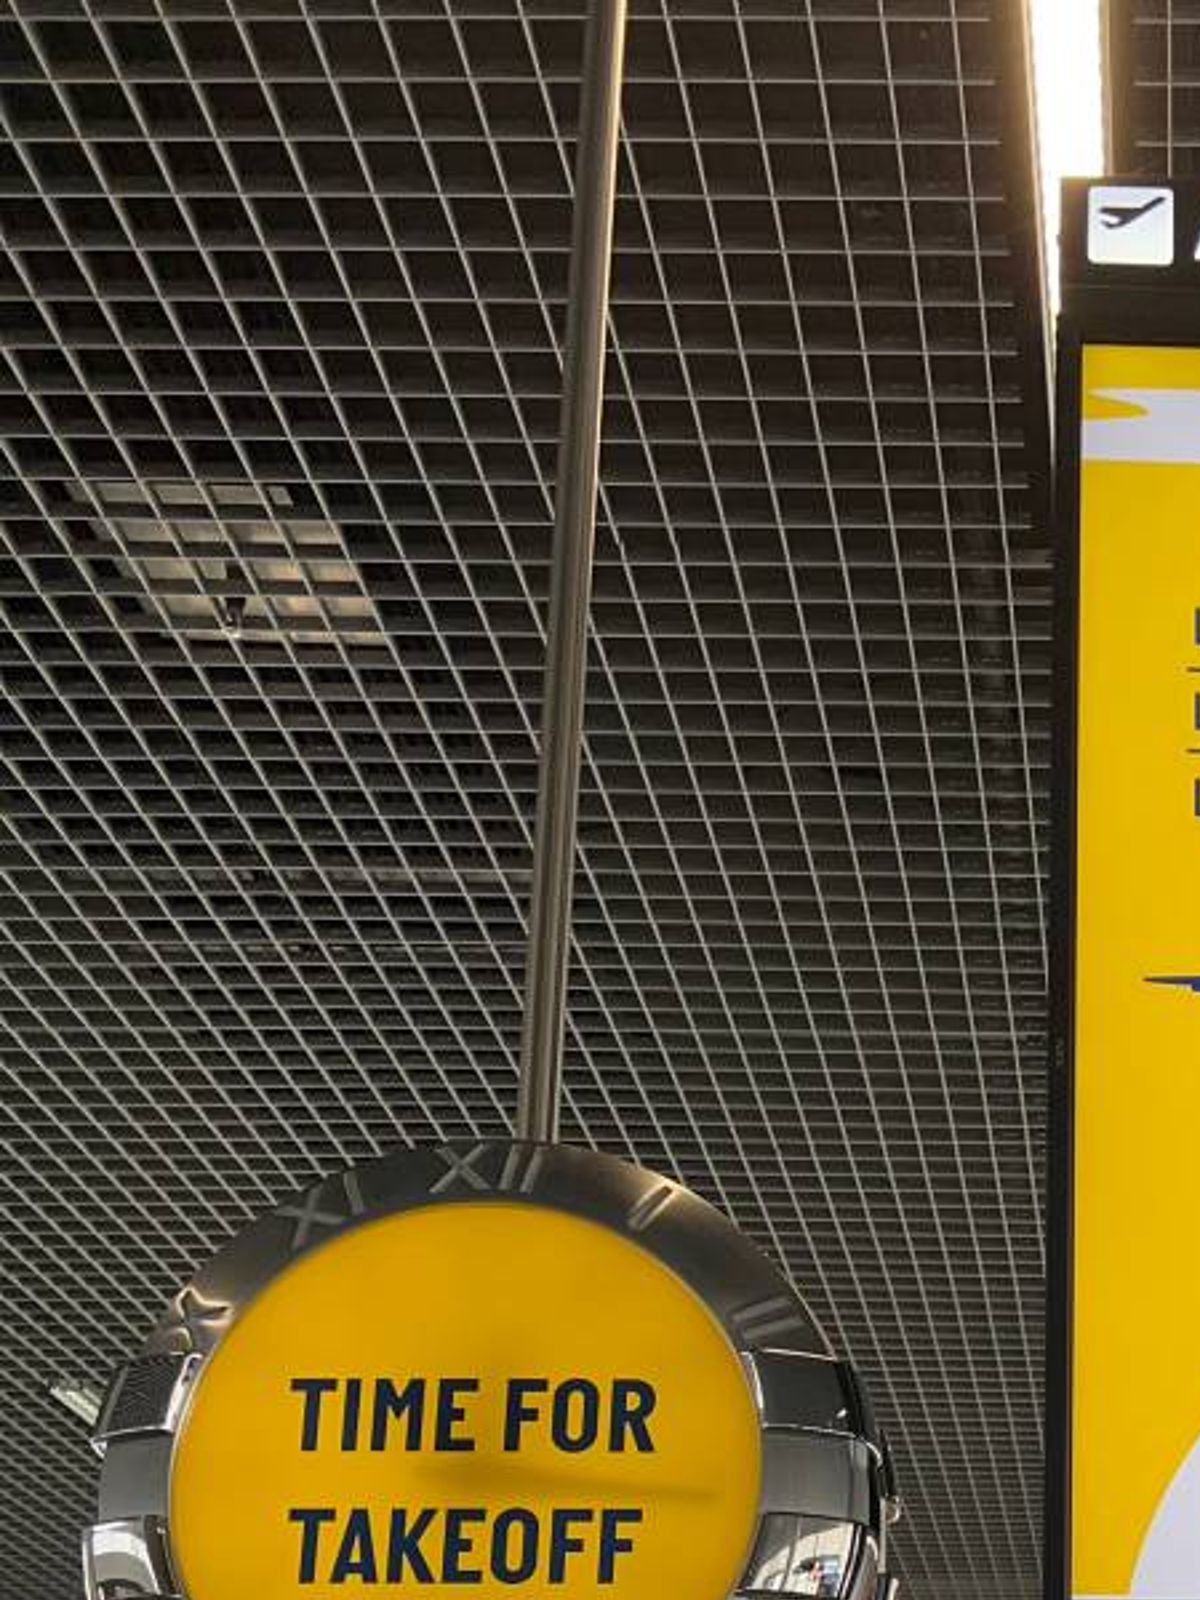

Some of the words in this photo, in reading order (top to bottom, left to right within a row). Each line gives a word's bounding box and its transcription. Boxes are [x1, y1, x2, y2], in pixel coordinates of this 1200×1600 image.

[290, 1378, 480, 1453] TIME
[502, 1378, 657, 1453] FOR
[288, 1507, 643, 1585] TAKEOFF
